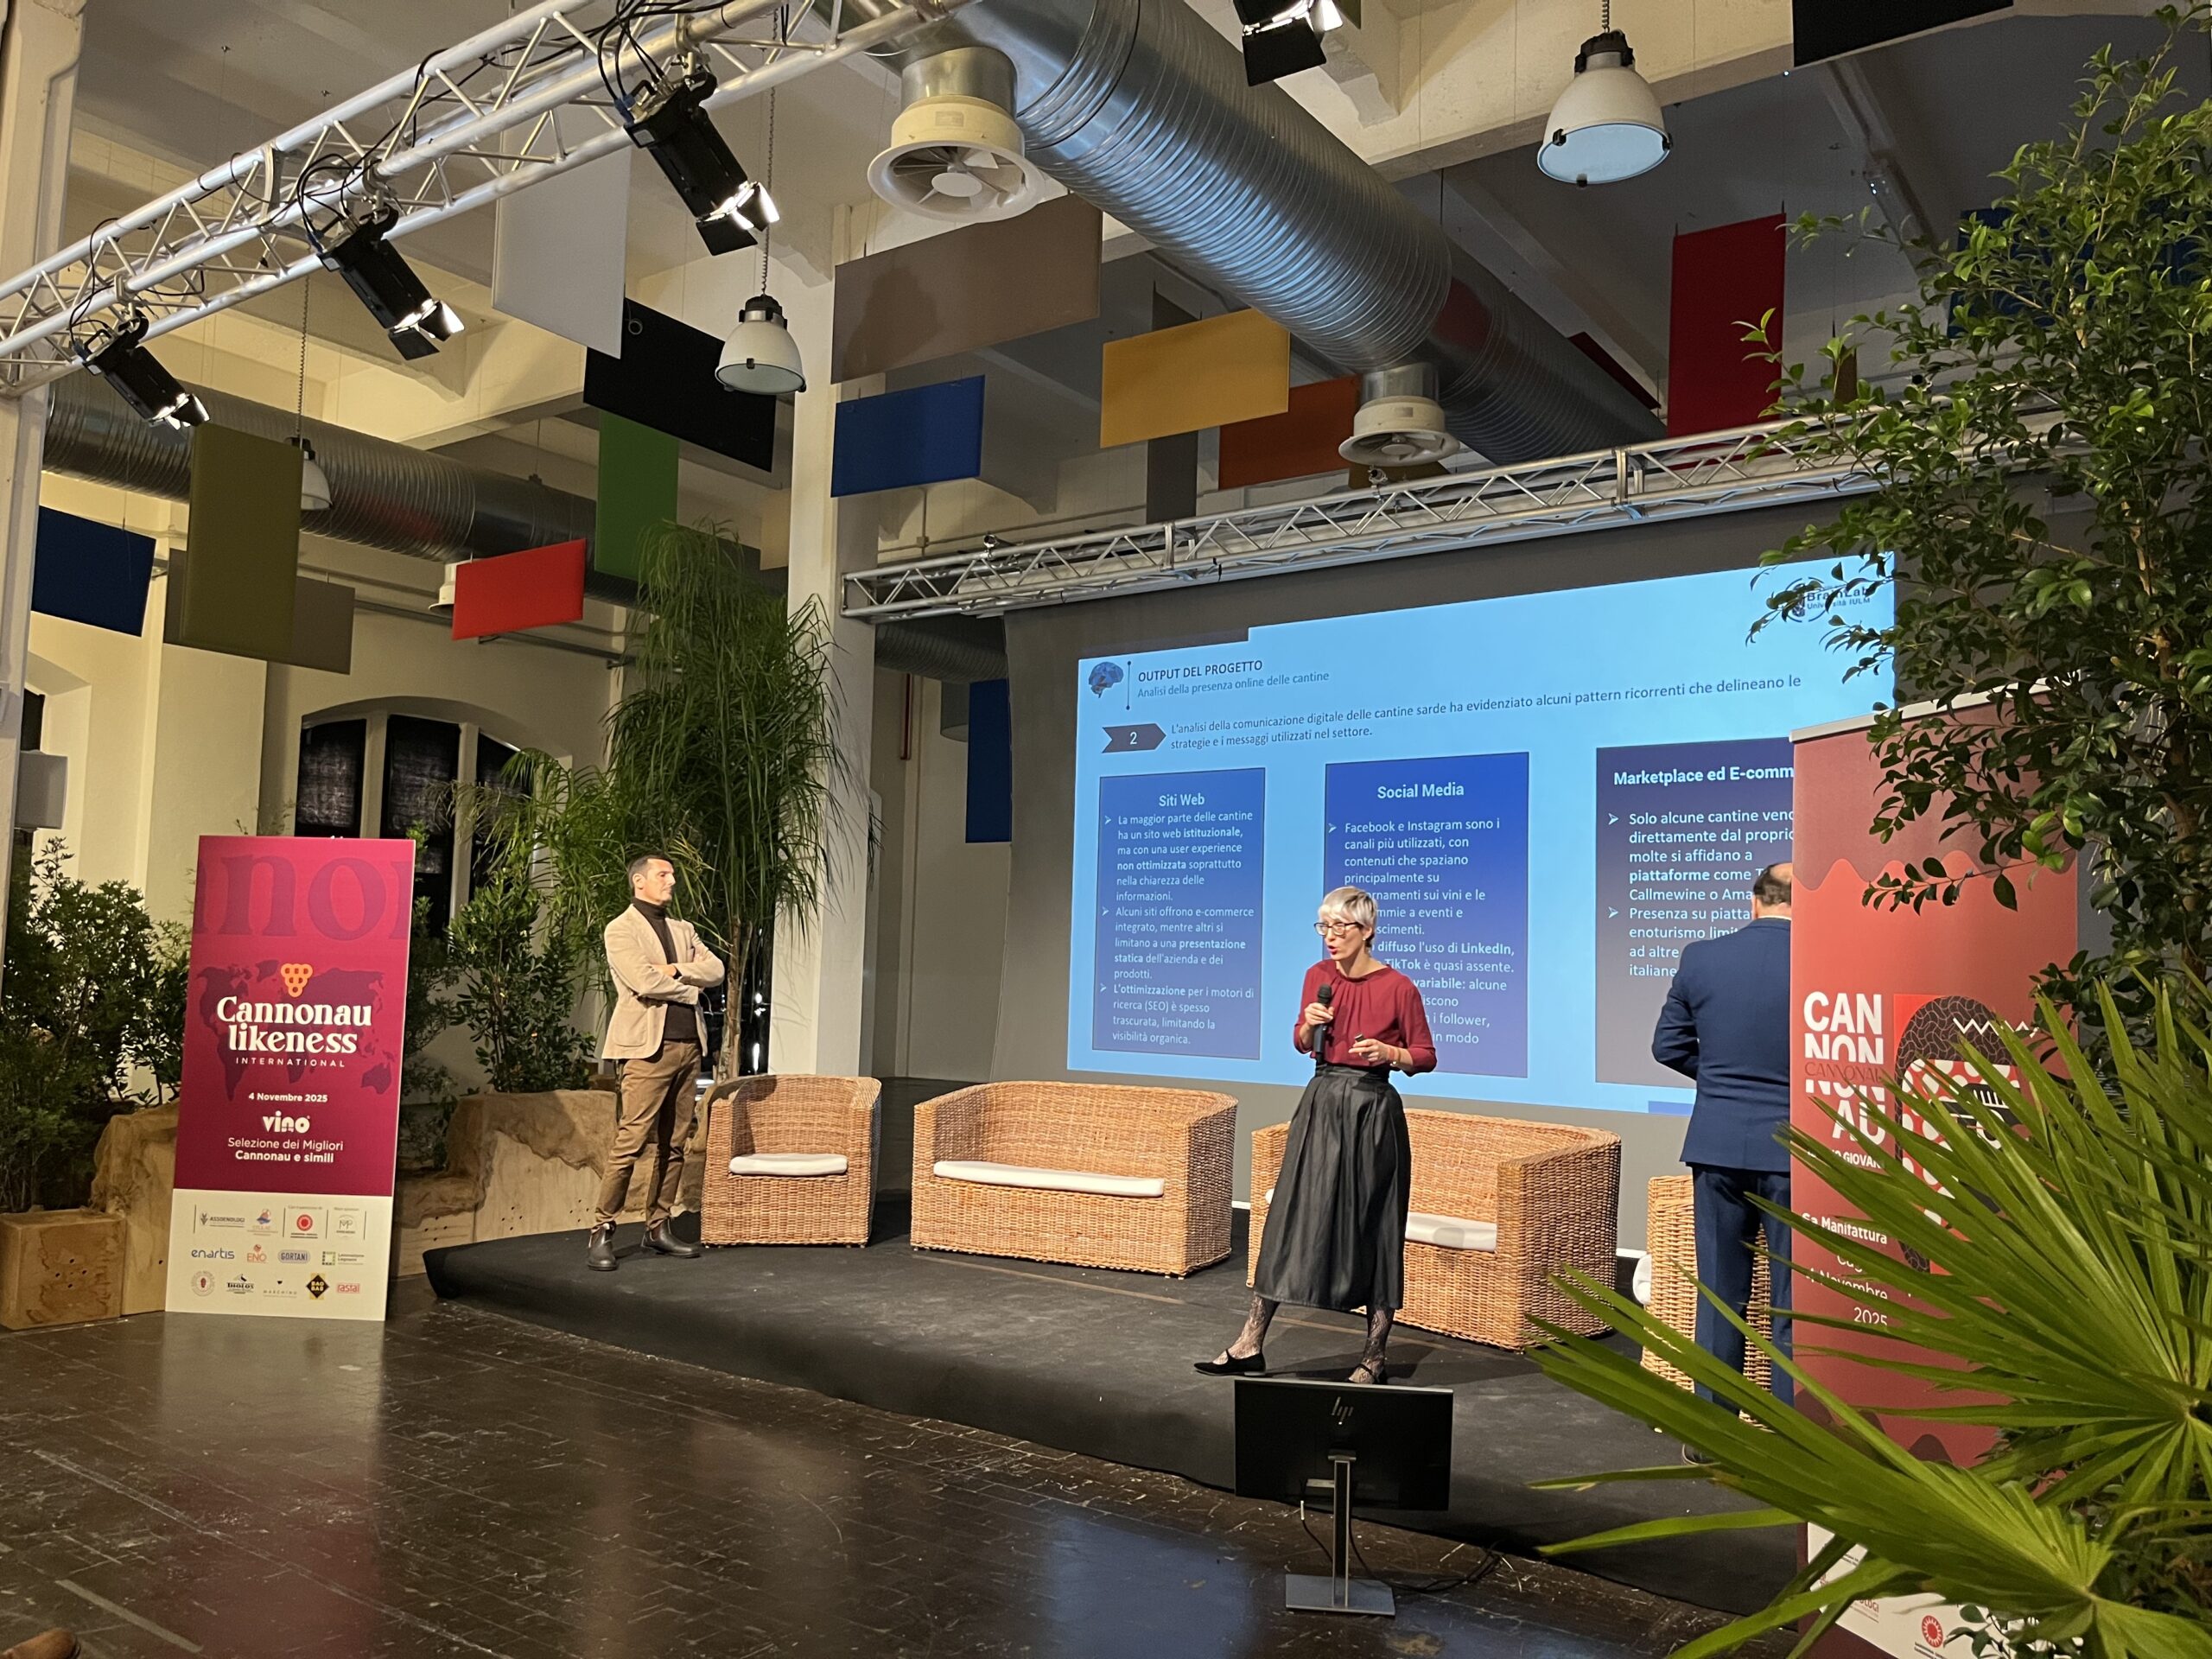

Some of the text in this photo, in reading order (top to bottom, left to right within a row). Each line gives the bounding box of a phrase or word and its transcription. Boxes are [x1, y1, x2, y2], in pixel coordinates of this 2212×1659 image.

[1138, 660, 1262, 682] OUTPUT DEL PROGETTO
[1137, 671, 1329, 697] Analisi della presenza online delle cantine
[1172, 675, 1802, 734] L'analisi della comunicazione digitale delle cantine sarde ha evidenziato alcuni pattern ricorrenti che delineano le
[1129, 731, 1137, 745] 2
[1171, 726, 1373, 750] strategie messaggi utilizzati nel settore.
[1613, 766, 1726, 786] Marketplace ed
[1377, 782, 1465, 798] Social Media
[1159, 793, 1205, 807] Siti Web
[1130, 811, 1253, 826] maggior parte delle cantine
[1630, 810, 1758, 825] Solo alcune cantine
[1345, 819, 1493, 833] Facebook Instagram sono
[1118, 827, 1243, 840] ha sito web istituzionale,
[1629, 829, 1741, 843] direttamente dal
[1192, 843, 1242, 855] experience
[1344, 836, 1469, 851] canali più utilizzati, con
[1344, 855, 1469, 868] contenuti che spaziano
[1630, 849, 1741, 862] molte si affidano
[1117, 859, 1242, 872] non ottimizzata soprattutto
[1116, 874, 1205, 886] nella chiarezza delle
[1344, 873, 1424, 885] principalmente
[1630, 868, 1711, 884] piattaforme
[1713, 870, 1751, 880] come
[1116, 892, 1173, 901] informazioni.
[1368, 889, 1462, 900] rnamenti sui vini
[1630, 888, 1706, 900] Callmewine
[1116, 906, 1254, 917] Alcuni siti offrono e-commerce
[1418, 906, 1453, 918] eventi
[1630, 908, 1707, 919] Presenza su
[1116, 923, 1214, 933] integrato, mentre altri
[1376, 924, 1425, 935] scimenti.
[1630, 926, 1706, 938] enoturismo
[1115, 938, 1150, 947] limitano
[1179, 939, 1246, 950] presentazione
[1377, 942, 1515, 957] diffuso l'uso LinkedIn,
[1630, 945, 1680, 958] ad altre
[1115, 954, 1224, 964] statica dell'azienda dei
[1384, 958, 1514, 973] TikTok quasi assente.
[1115, 969, 1153, 981] prodotti.
[1630, 964, 1676, 976] italiane
[1414, 977, 1507, 990] variabile: alcune
[1114, 985, 1243, 998] L'ottimizzazione per motori
[217, 995, 372, 1027] Cannonau
[1114, 1001, 1210, 1014] ricerca (SEO) spesso
[1802, 990, 1882, 1035] CAN
[1113, 1015, 1205, 1029] trascurata, limitando
[1440, 1013, 1490, 1027] follower,
[228, 1022, 358, 1054] likeness
[1113, 1032, 1191, 1045] visibilità organica.
[1446, 1033, 1479, 1044] modo
[236, 1058, 345, 1068] INTERNATIONAL
[257, 1093, 303, 1102] Novembre
[305, 1094, 327, 1103] 2025
[1832, 1099, 1886, 1145] AU
[228, 1137, 343, 1151] Selezione dei Migliori
[235, 1150, 334, 1163] Cannonau simili
[1821, 1217, 1887, 1244] Manifattura
[191, 1248, 235, 1259] enartis
[247, 1253, 267, 1262] ENO
[281, 1252, 308, 1261] GORTANI
[1853, 1306, 1887, 1325] 2025
[1332, 1396, 1354, 1425] hp
